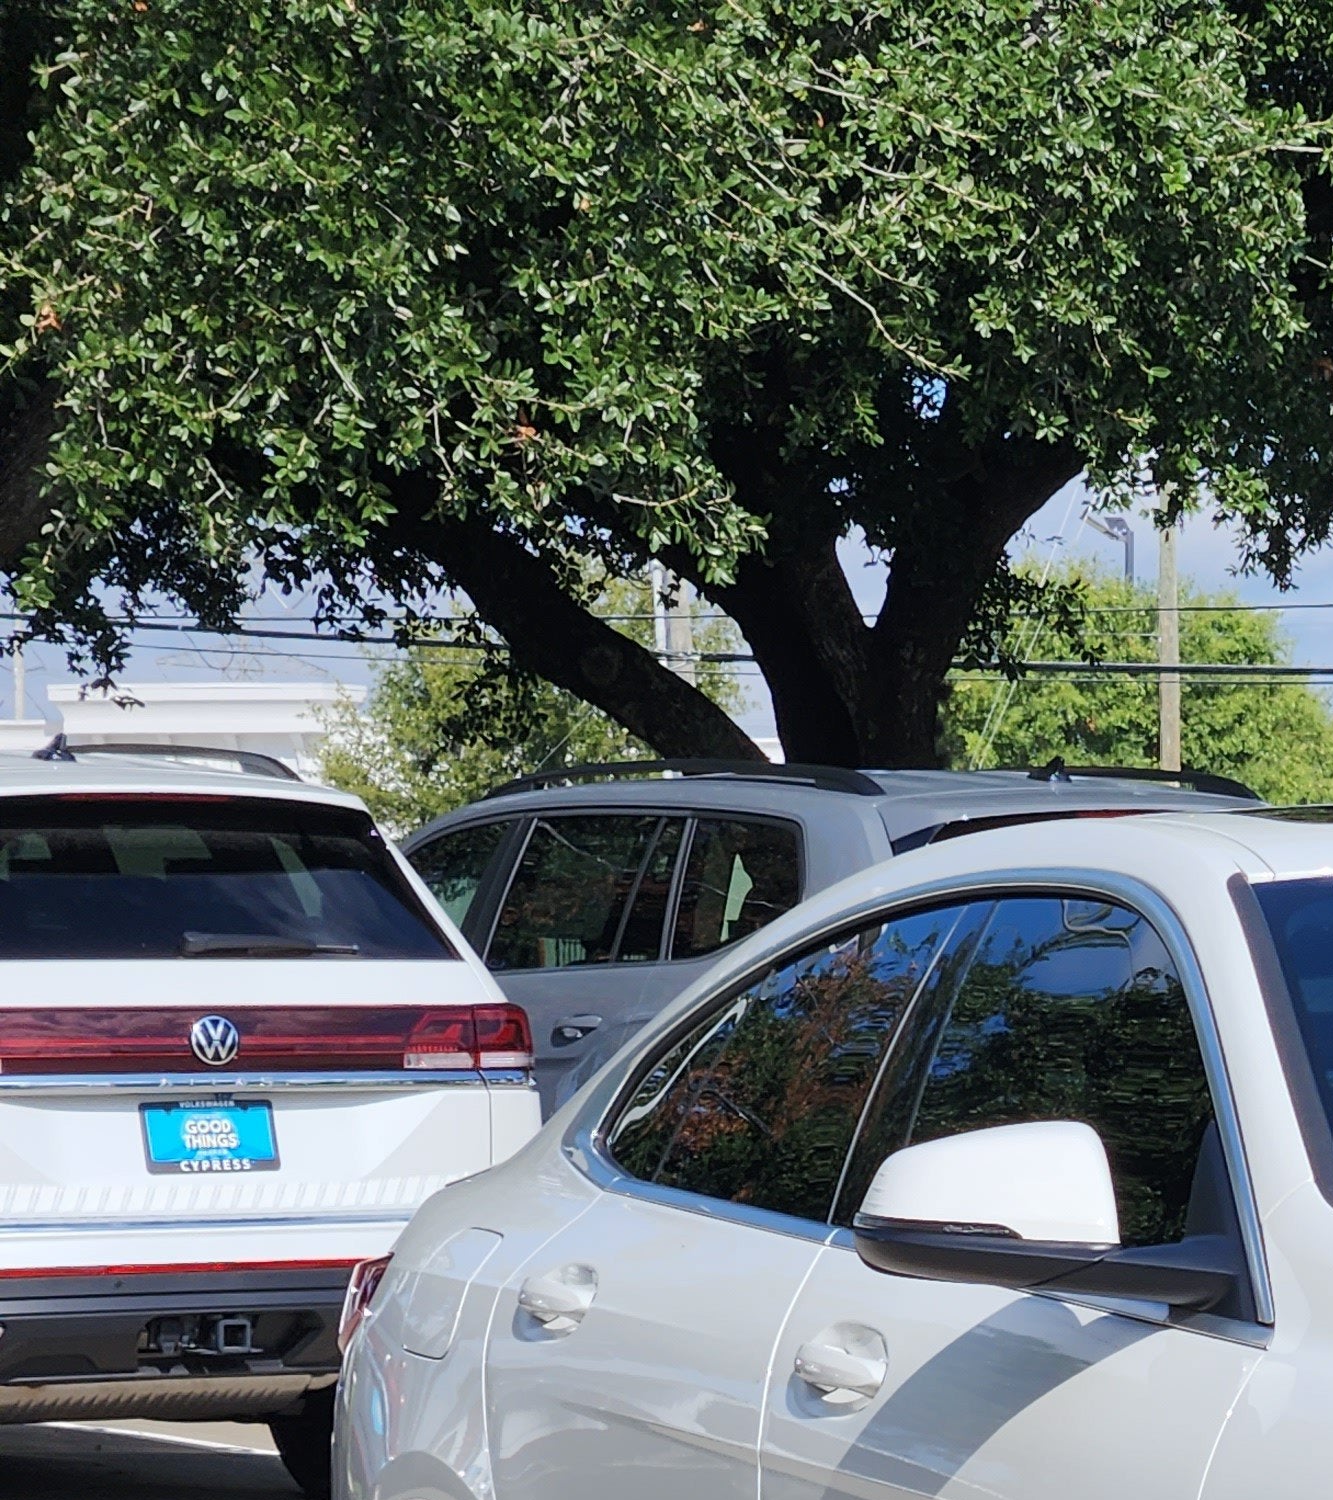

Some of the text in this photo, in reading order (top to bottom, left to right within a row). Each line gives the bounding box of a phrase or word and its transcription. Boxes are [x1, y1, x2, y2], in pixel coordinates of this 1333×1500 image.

[185, 1119, 232, 1135] GOOD
[183, 1132, 240, 1150] THINGS
[179, 1158, 251, 1171] CYPRESS
